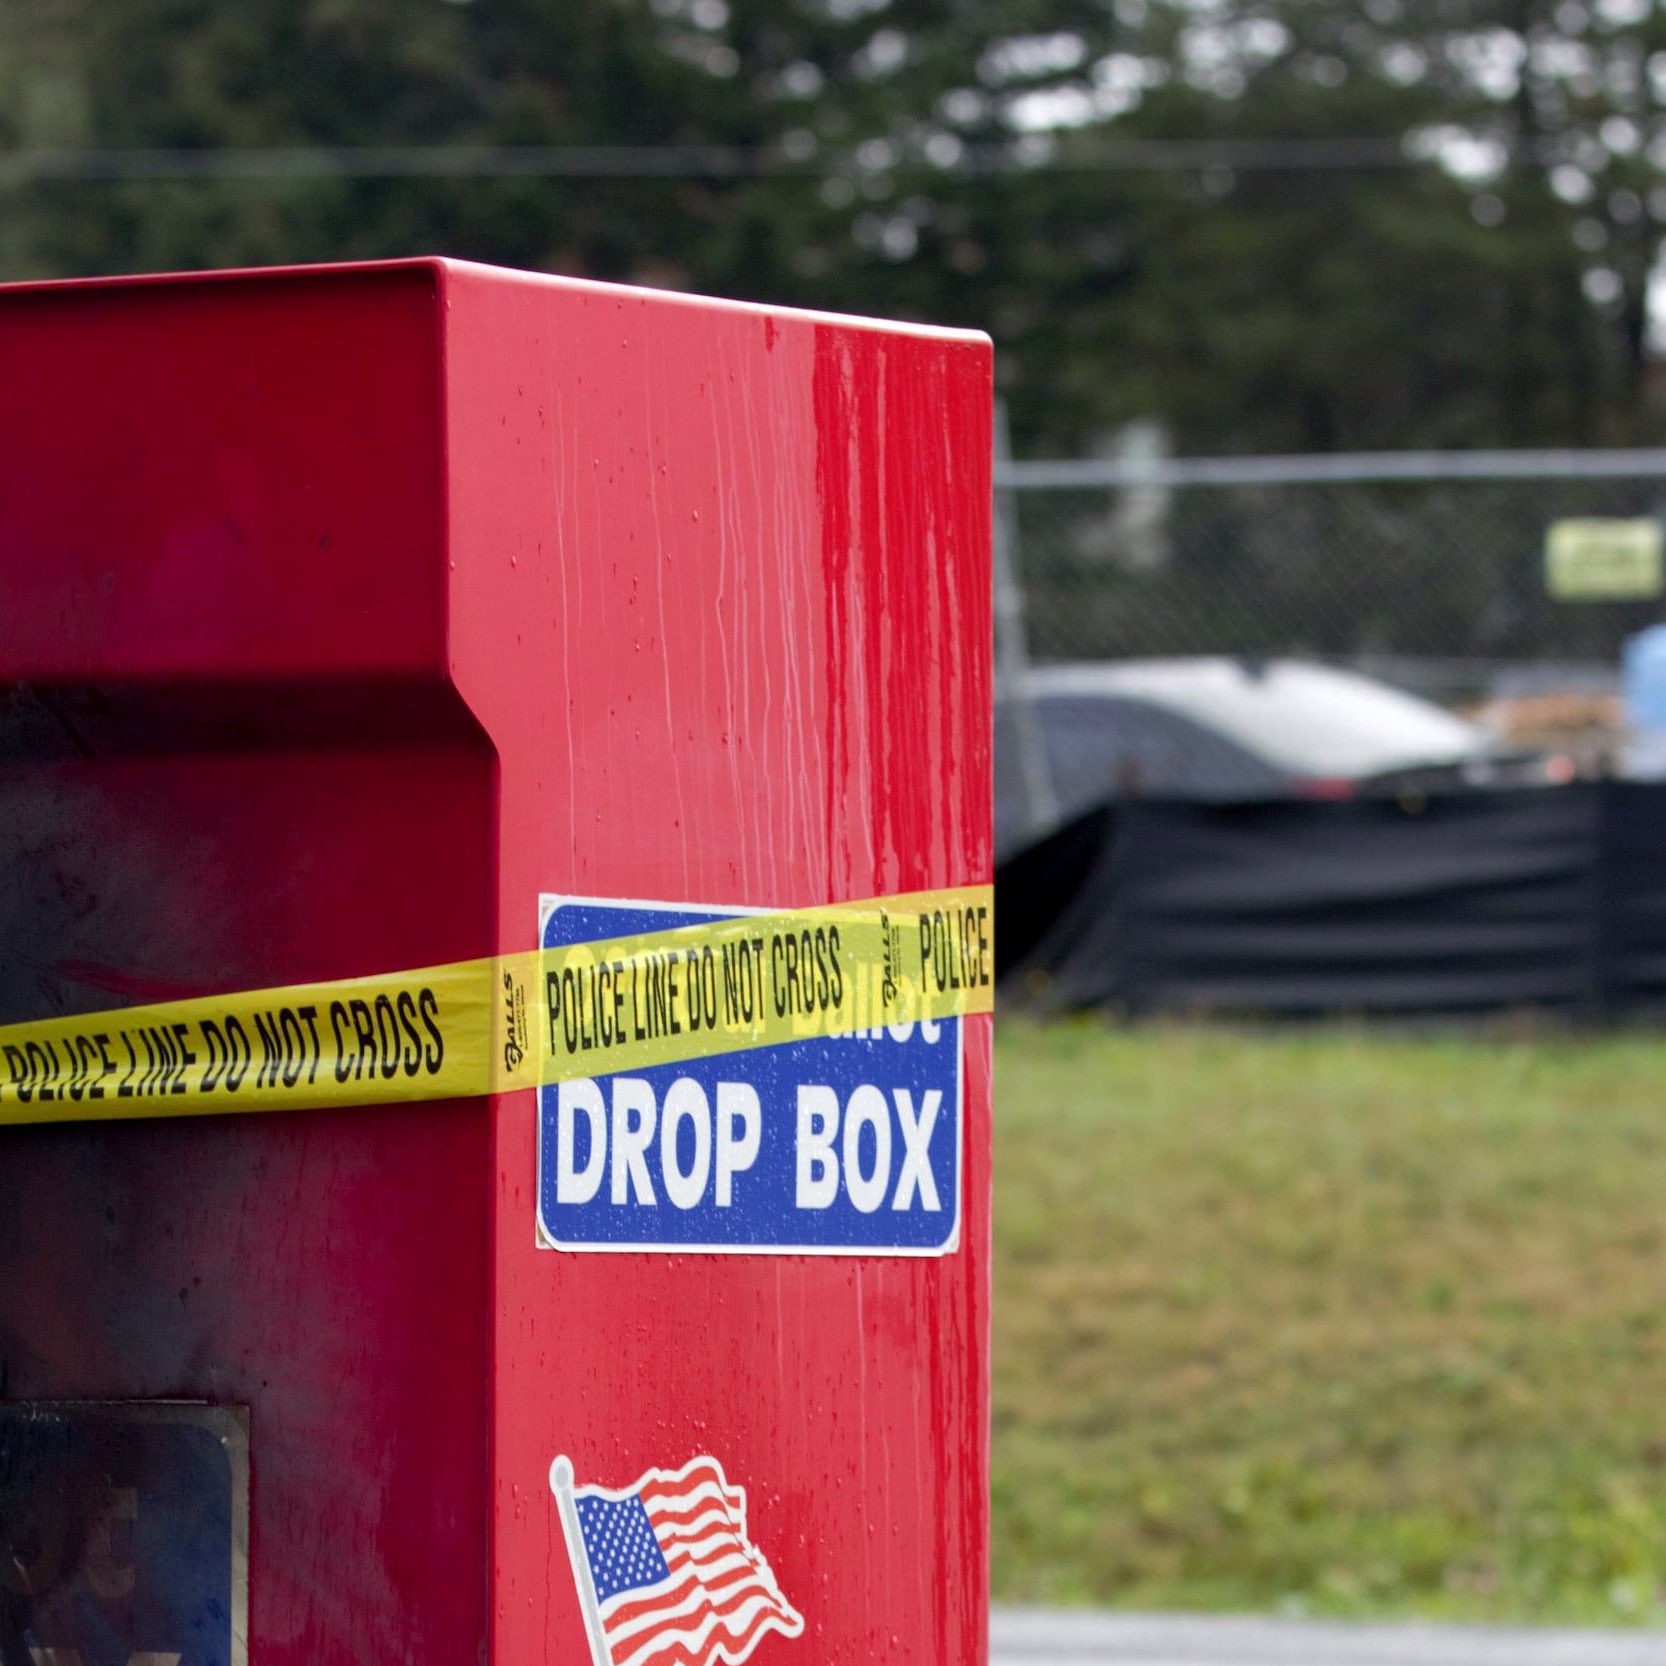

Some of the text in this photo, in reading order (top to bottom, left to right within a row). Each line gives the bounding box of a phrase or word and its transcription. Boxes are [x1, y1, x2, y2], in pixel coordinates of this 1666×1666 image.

[546, 961, 626, 1056] POLICE
[631, 952, 680, 1041] LINE
[685, 944, 717, 1033] DO
[722, 938, 764, 1028] NOT
[771, 924, 843, 1018] CROSS
[919, 907, 989, 993] POLICE
[118, 1023, 196, 1098] LINE
[199, 1015, 251, 1092] DO
[253, 1006, 317, 1089] NOT
[329, 988, 444, 1083] CROSS
[556, 1077, 943, 1213] DROP BOX
